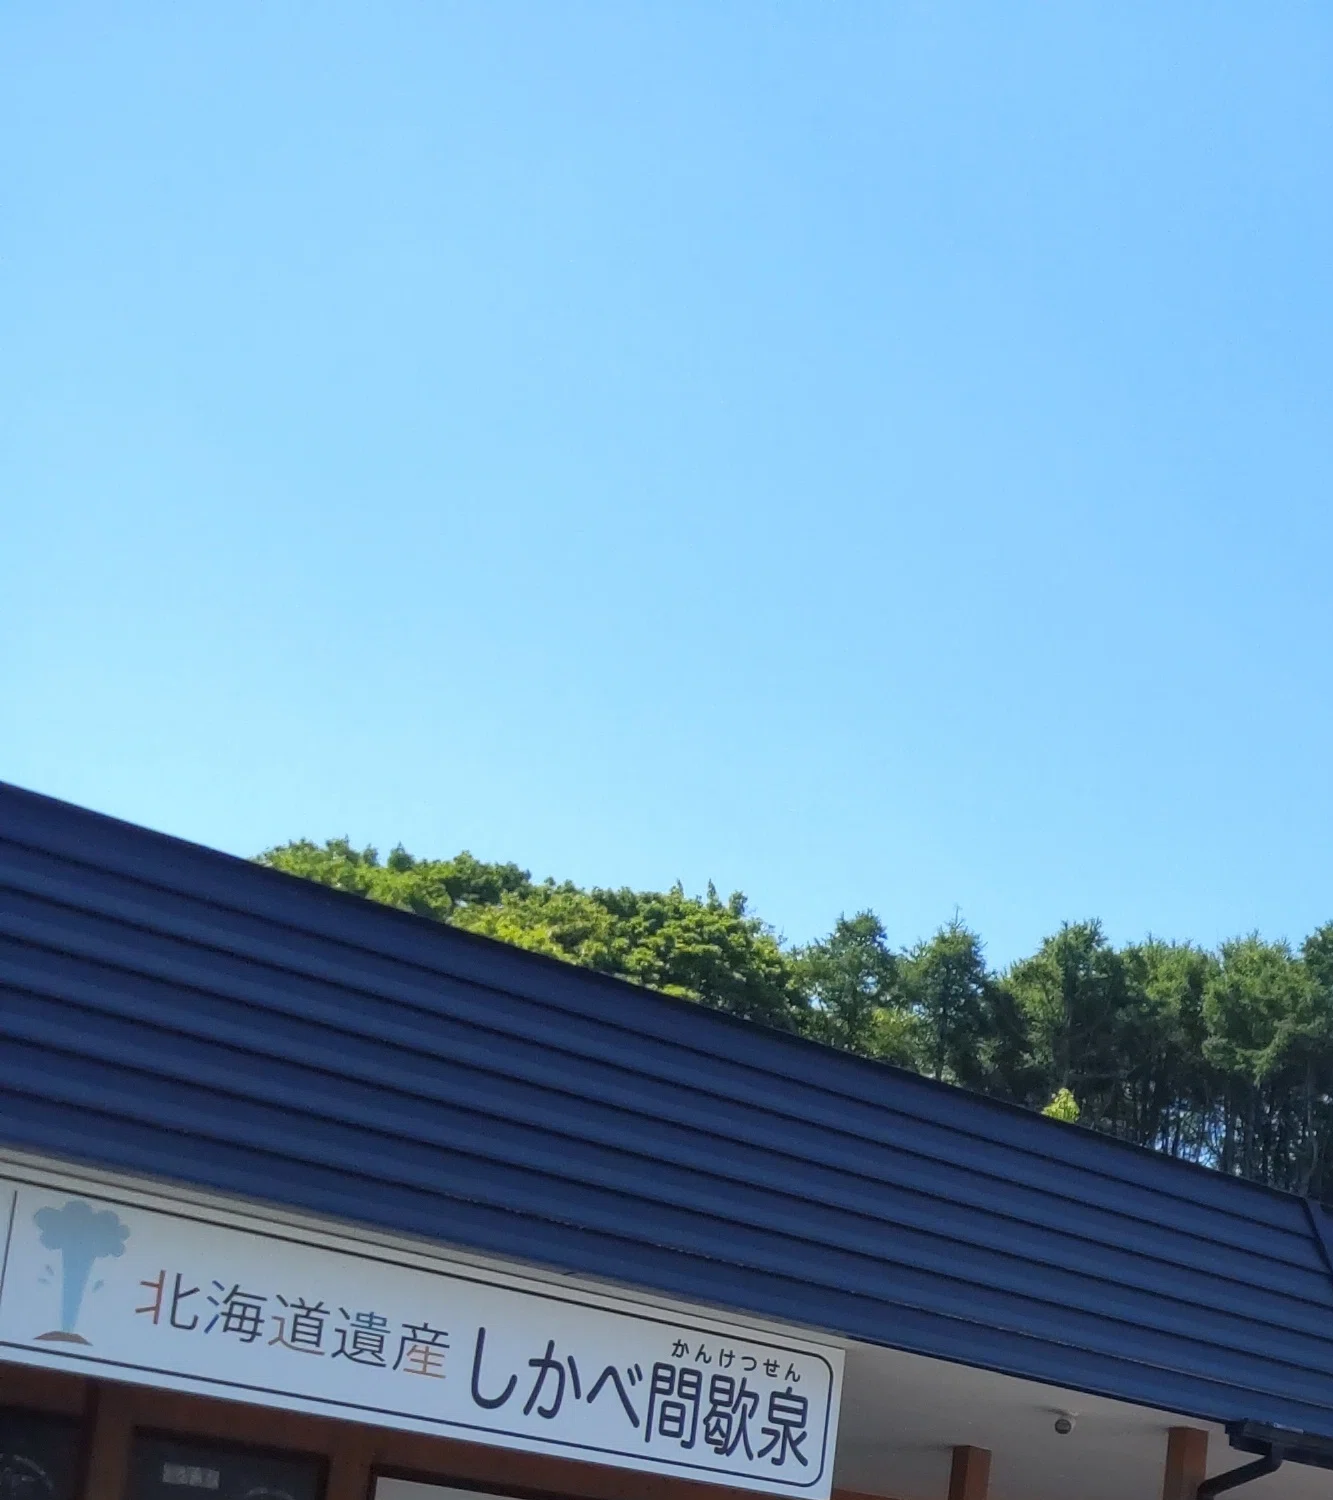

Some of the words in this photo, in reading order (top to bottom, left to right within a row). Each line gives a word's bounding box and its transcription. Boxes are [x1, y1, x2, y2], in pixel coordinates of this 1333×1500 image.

[135, 1269, 450, 1380] 北海道遺産
[471, 1326, 809, 1467] しかべ間歇泉
[672, 1338, 802, 1383] かんけつせん
